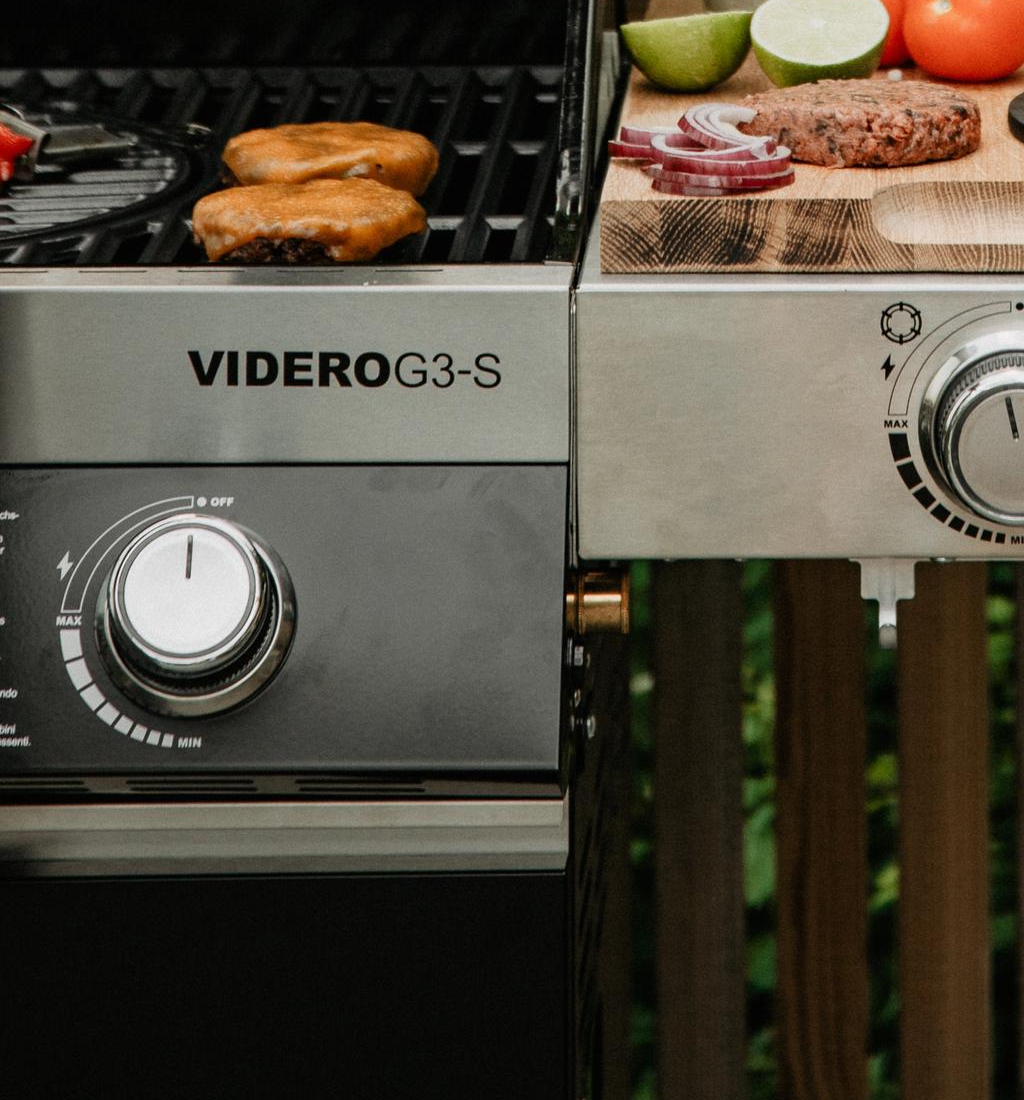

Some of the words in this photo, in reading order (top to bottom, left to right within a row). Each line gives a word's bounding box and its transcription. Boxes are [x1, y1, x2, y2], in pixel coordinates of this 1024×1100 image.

[883, 419, 909, 429] MAX
[210, 496, 235, 507] OFF
[55, 615, 83, 626] MAX
[177, 737, 202, 748] MIN
